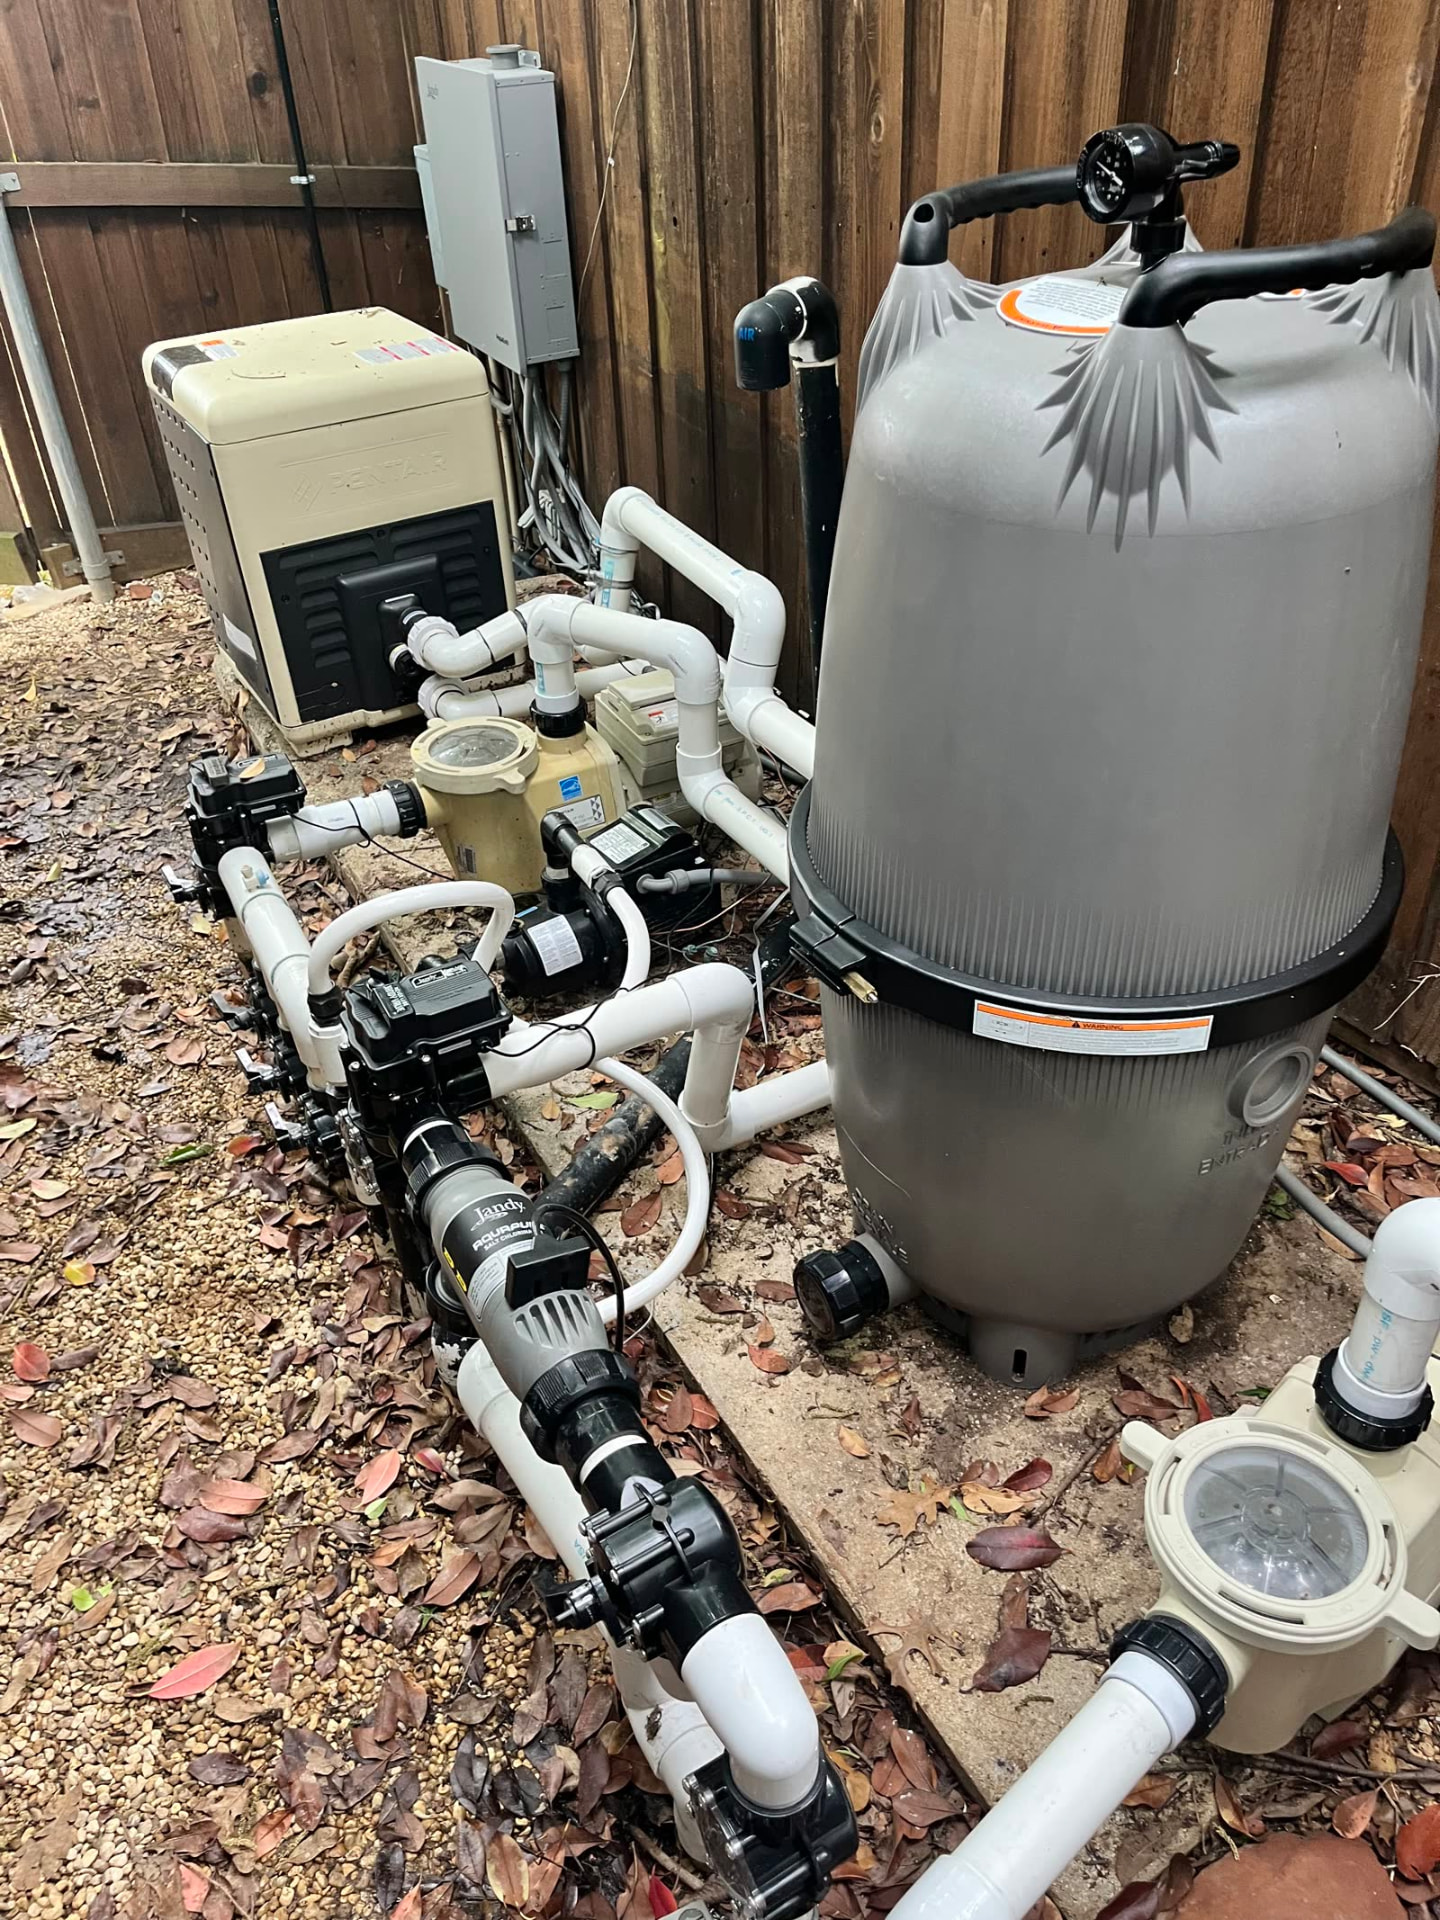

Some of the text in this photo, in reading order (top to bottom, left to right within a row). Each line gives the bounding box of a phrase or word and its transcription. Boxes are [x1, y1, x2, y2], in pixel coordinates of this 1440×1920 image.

[738, 326, 755, 341] AIR
[327, 449, 449, 496] PENTAIR
[1082, 1022, 1124, 1030] WARNING
[474, 1198, 526, 1225] Jandy
[472, 1221, 545, 1251] AQUAPU
[483, 1239, 500, 1251] SALT
